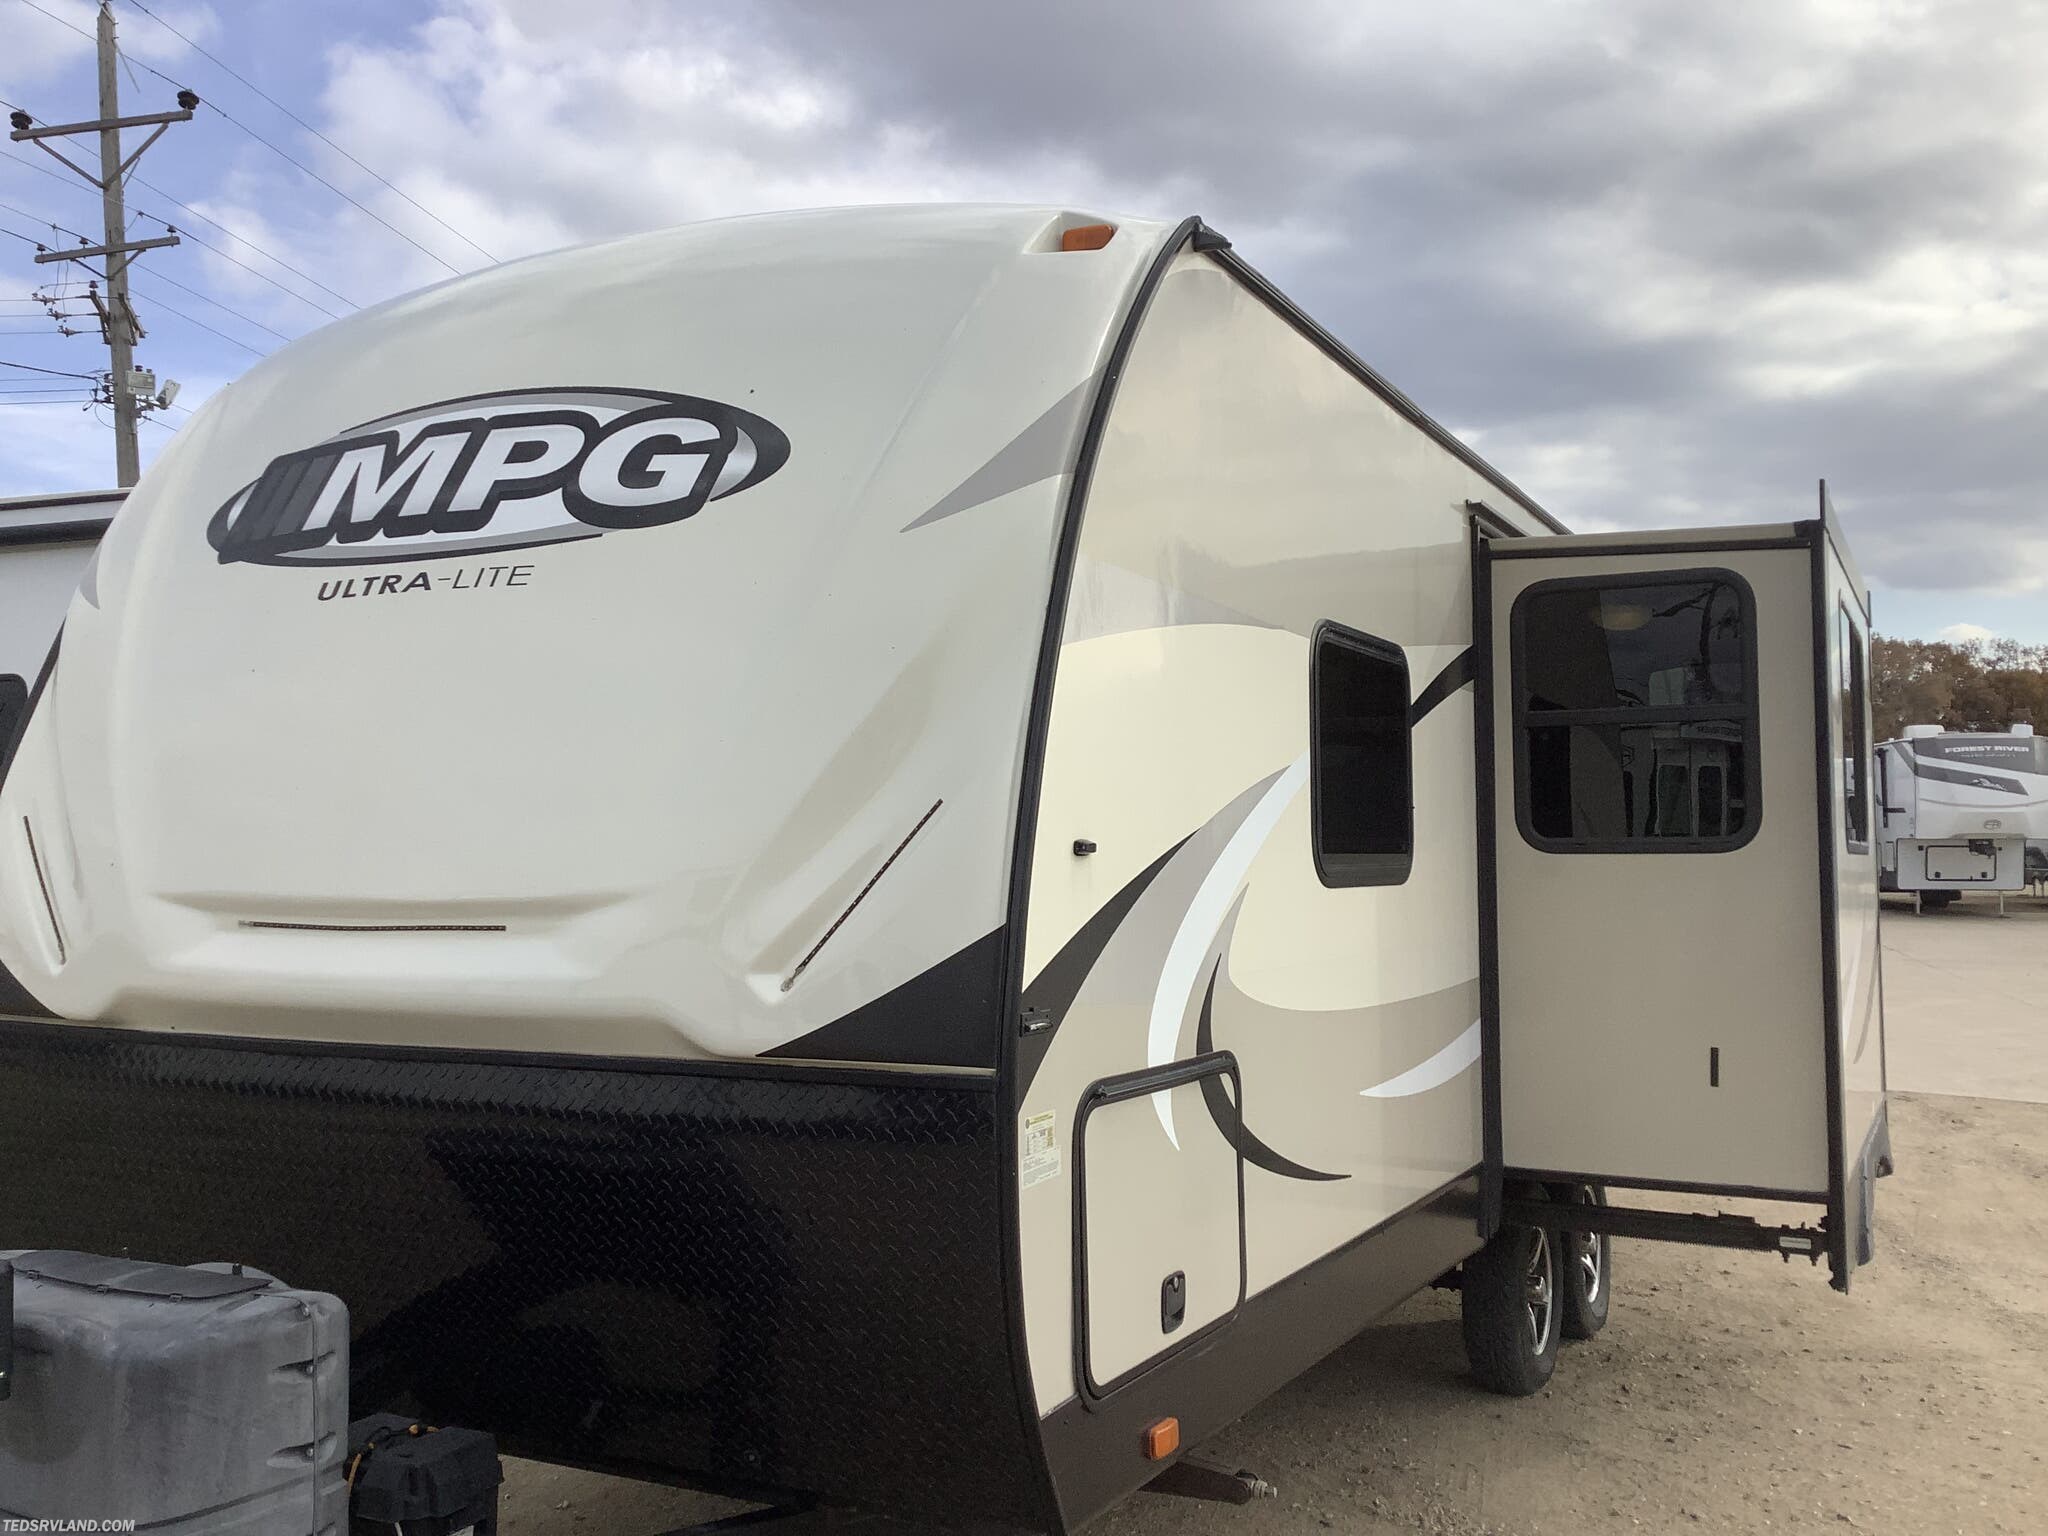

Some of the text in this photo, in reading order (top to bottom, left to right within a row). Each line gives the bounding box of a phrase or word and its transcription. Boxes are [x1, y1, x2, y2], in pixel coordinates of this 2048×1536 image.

[300, 416, 722, 532] MPG
[317, 564, 536, 602] ULTRA-LITE
[1944, 745, 2029, 754] FOREST RIVER
